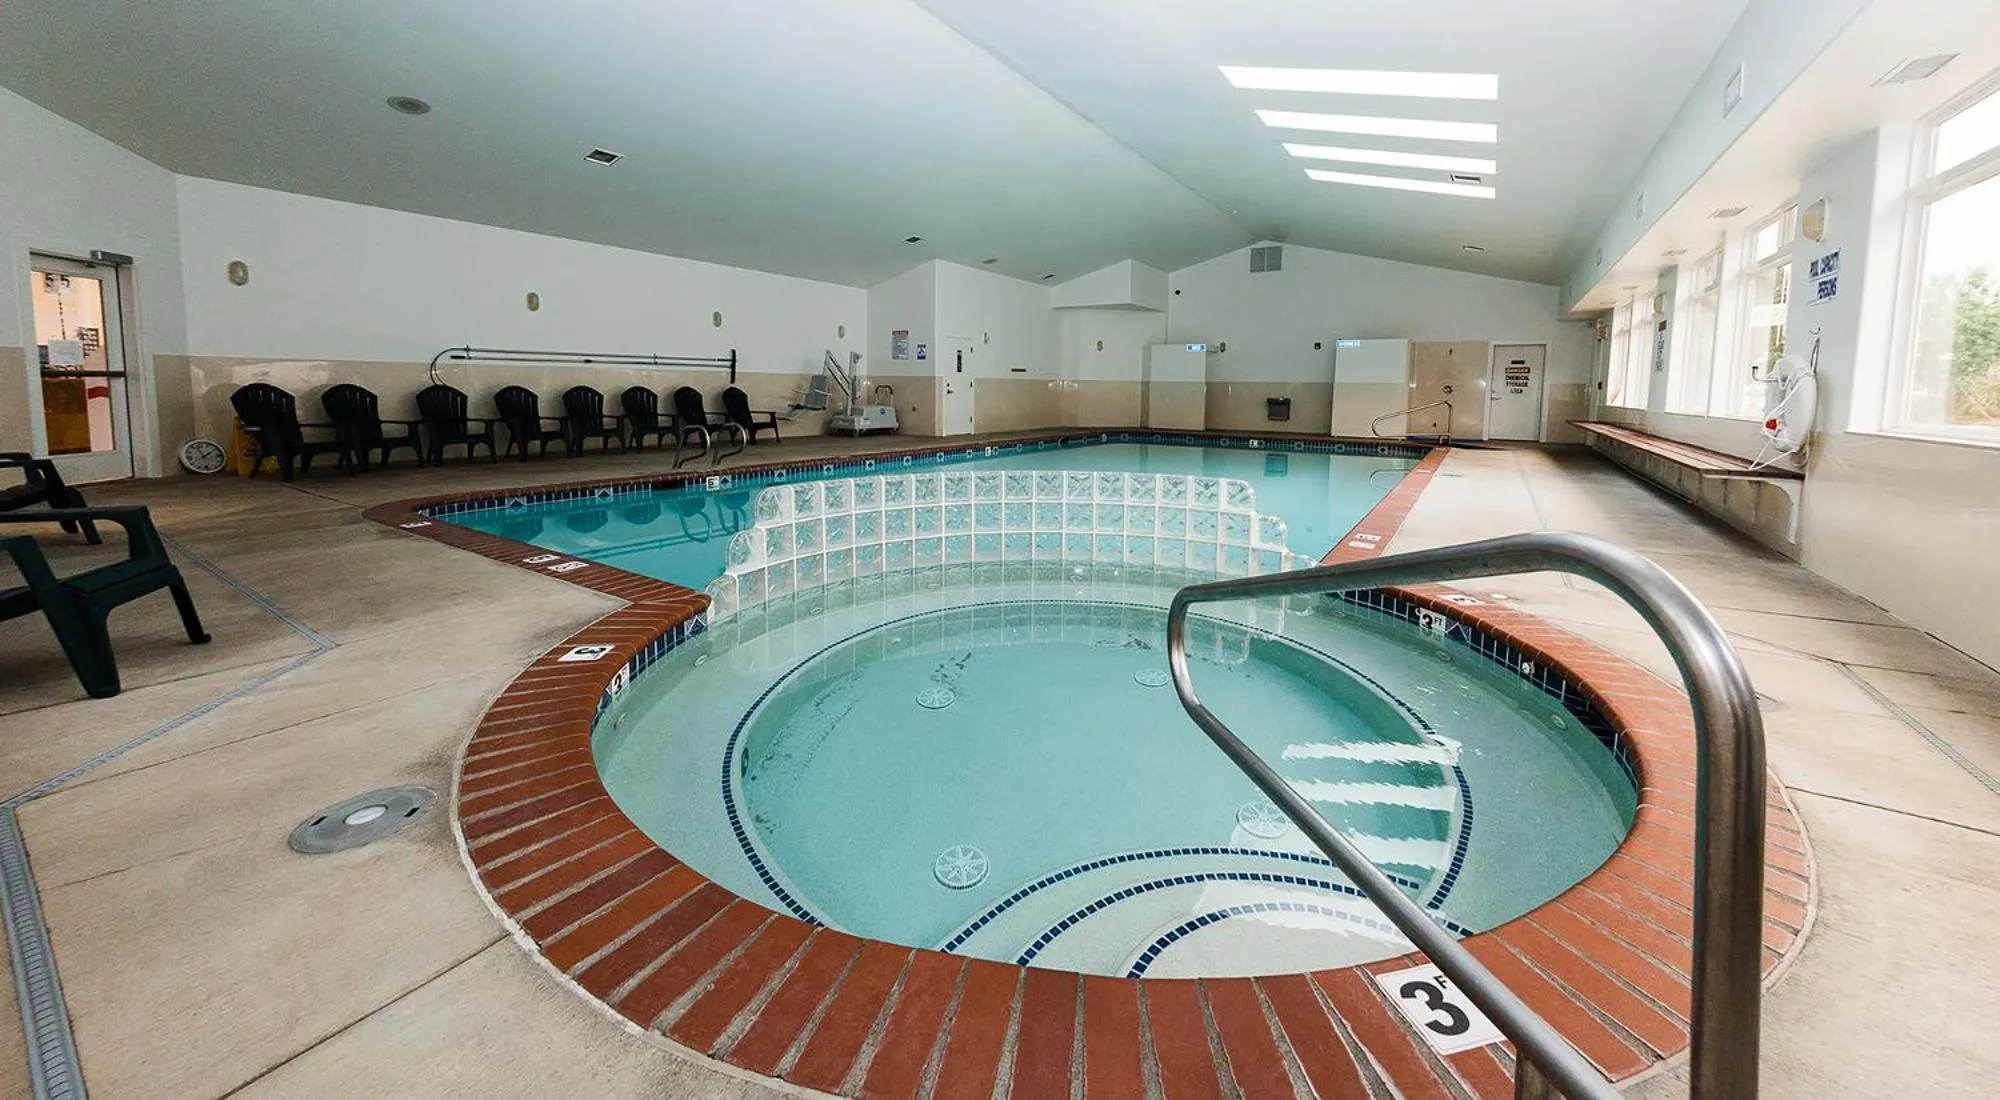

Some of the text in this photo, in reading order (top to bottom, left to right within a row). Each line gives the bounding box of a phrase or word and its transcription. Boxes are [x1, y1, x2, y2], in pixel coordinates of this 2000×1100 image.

[1422, 613, 1433, 629] 3
[575, 647, 607, 655] 3
[614, 673, 622, 695] 3
[1433, 975, 1448, 989] F
[1400, 981, 1470, 1036] 3
